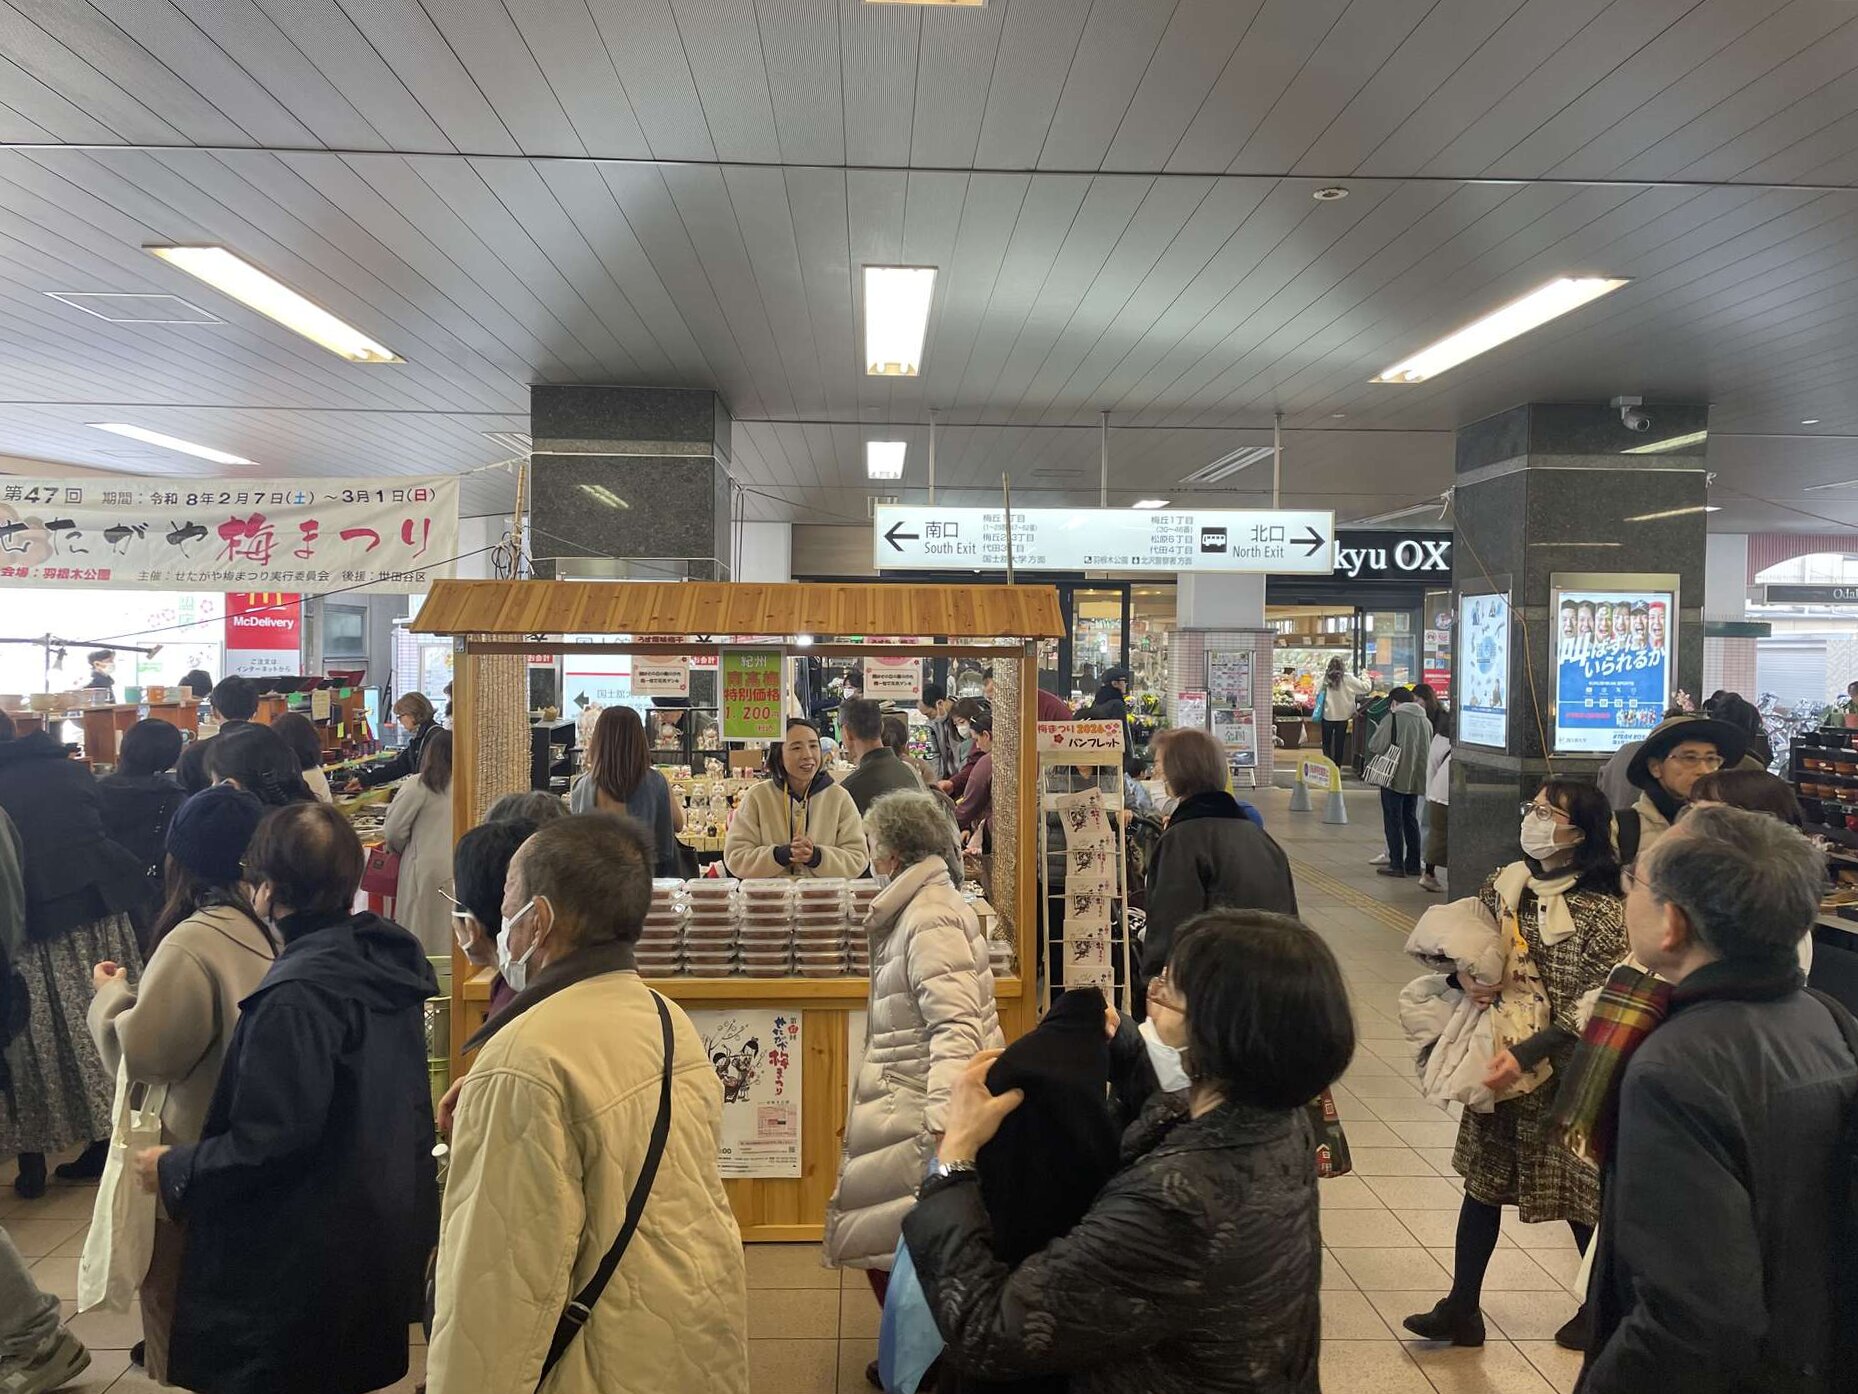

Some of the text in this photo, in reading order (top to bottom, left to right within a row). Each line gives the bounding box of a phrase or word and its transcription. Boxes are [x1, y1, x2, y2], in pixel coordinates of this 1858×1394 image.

[3, 485, 83, 504] 第47回
[925, 521, 959, 538] 南口
[1250, 524, 1285, 543] 北口
[0, 512, 431, 566] せたがや梅まつり
[983, 533, 1034, 542] 梅丘23丁目
[924, 542, 976, 554] South Exit
[1232, 545, 1284, 558] North Exit
[1333, 540, 1451, 577] kyu OX
[233, 616, 294, 629] McDelivery
[740, 655, 767, 668] 紀州
[724, 688, 780, 702] 特別価格
[1038, 724, 1104, 734] 梅まつり 2026
